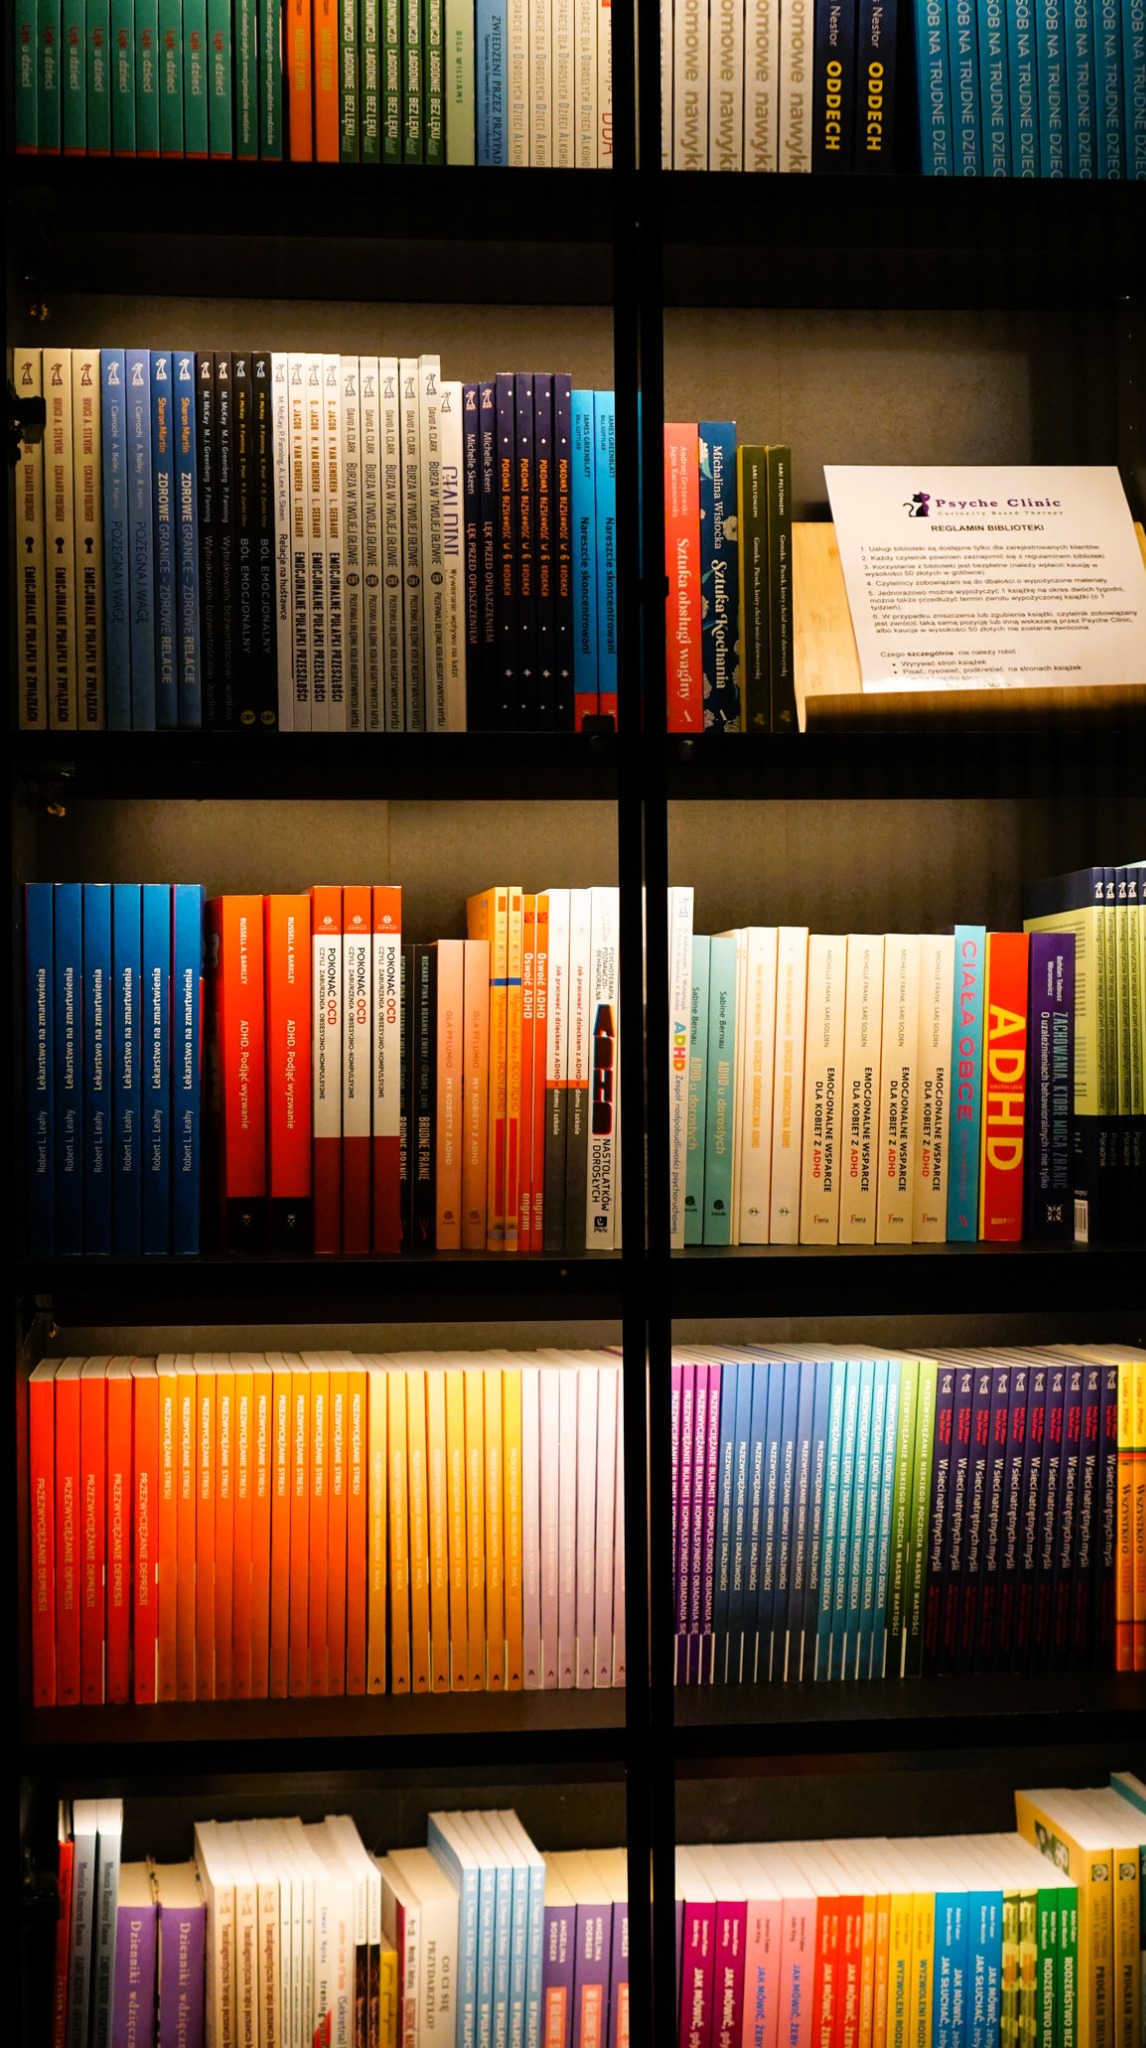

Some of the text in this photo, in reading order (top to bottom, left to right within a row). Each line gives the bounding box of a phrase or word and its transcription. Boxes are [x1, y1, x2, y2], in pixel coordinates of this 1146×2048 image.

[213, 32, 225, 96] Lęk dzieci
[428, 51, 440, 139] ŁAGODNIE BEZ LĘKU
[492, 15, 501, 113] ZWIEDZENI PRZEZ
[867, 7, 884, 151] Nestor ODDECH
[928, 31, 944, 124] NA TRUDNE
[785, 92, 807, 173] nawyki
[220, 402, 228, 483] McKay Greenberg
[385, 410, 397, 567] DAVID CLARK BURZA TWOJEJ GŁOWIE
[935, 498, 1061, 509] Psyche Clinic
[182, 397, 195, 683] Sharon Martin ZDROWE GRANICE ZDROWE RELACJE
[482, 432, 494, 642] Michelle Skeen LĘK PRZED OPUSZCZENIEM
[559, 459, 568, 596] POKONAJ KROKACH
[84, 567, 95, 625] EMOCJONALNE
[135, 522, 148, 624] POŻEGNAJ WAGĘ
[260, 539, 270, 653] BÓL EMOCJONALNY
[278, 534, 288, 620] Relacje na huśtawce
[580, 517, 591, 654] Nareszcie skoncentrowani
[711, 445, 729, 689] Michalina Wisłocka Sztuka Kochania
[85, 629, 96, 663] PUŁAPKI
[329, 552, 344, 702] EMOCJONALNE PUŁAPKI PRZESZŁOŚCI
[676, 538, 692, 700] Sztuka obsługi waginy
[387, 947, 396, 1023] POKONAĆ OCD
[960, 940, 977, 1028] CIAŁA
[1056, 956, 1064, 1002] Bohdan Tadeusz
[285, 1052, 296, 1082] Podjąć
[287, 1020, 295, 1049] ADHD.
[673, 1021, 686, 1071] ADHD
[37, 969, 48, 1172] Robert Leahy Lekarstwo na zmartwienia
[534, 953, 547, 1230] Oswoić ADHD engram
[673, 1075, 684, 1100] Zespół
[715, 991, 730, 1154] Sabine Bernau ADHD dorosłych
[957, 1037, 974, 1122] OBCE
[987, 1004, 1026, 1171] ADHD
[1040, 1020, 1050, 1189] uzależnieniach behawioralnych tylko
[286, 1084, 294, 1129] wyzwanie
[671, 1103, 683, 1169] nadpobudliwości
[922, 1081, 932, 1177] DLA KOBIET ADHD
[933, 1067, 944, 1191] EMOCJONALNE WSPARCIE
[418, 1117, 430, 1180] BRUDNE PRANIE
[592, 1145, 602, 1203] DOROSŁYCH
[601, 1139, 613, 1211] NASTOLATKÓW
[138, 1472, 148, 1559] PRZEZWYCIĘŻANIE
[708, 1467, 716, 1498] BULIMII
[919, 1462, 928, 1502] NISKIEGO
[937, 1470, 946, 1492] sieci
[705, 1506, 714, 1573] KOMPULSYJNEGO
[722, 1508, 730, 1536] GNIEWU
[916, 1506, 924, 1548] POCZUCIA
[933, 1494, 945, 1545] natrętnych
[824, 1538, 834, 1575] TWOJEGO
[914, 1551, 923, 1589] WŁASNEJ
[932, 1547, 943, 1572] myśli
[823, 1578, 832, 1610] DZIECKA
[179, 1923, 191, 1986] Dzienniki
[440, 1956, 450, 2013] CO CI SIĘ
[975, 1954, 983, 1973] JAK
[988, 1966, 996, 1985] JAK
[1064, 1957, 1074, 2026] RODZEŃSTWO
[790, 2023, 800, 2045] ŻEBY
